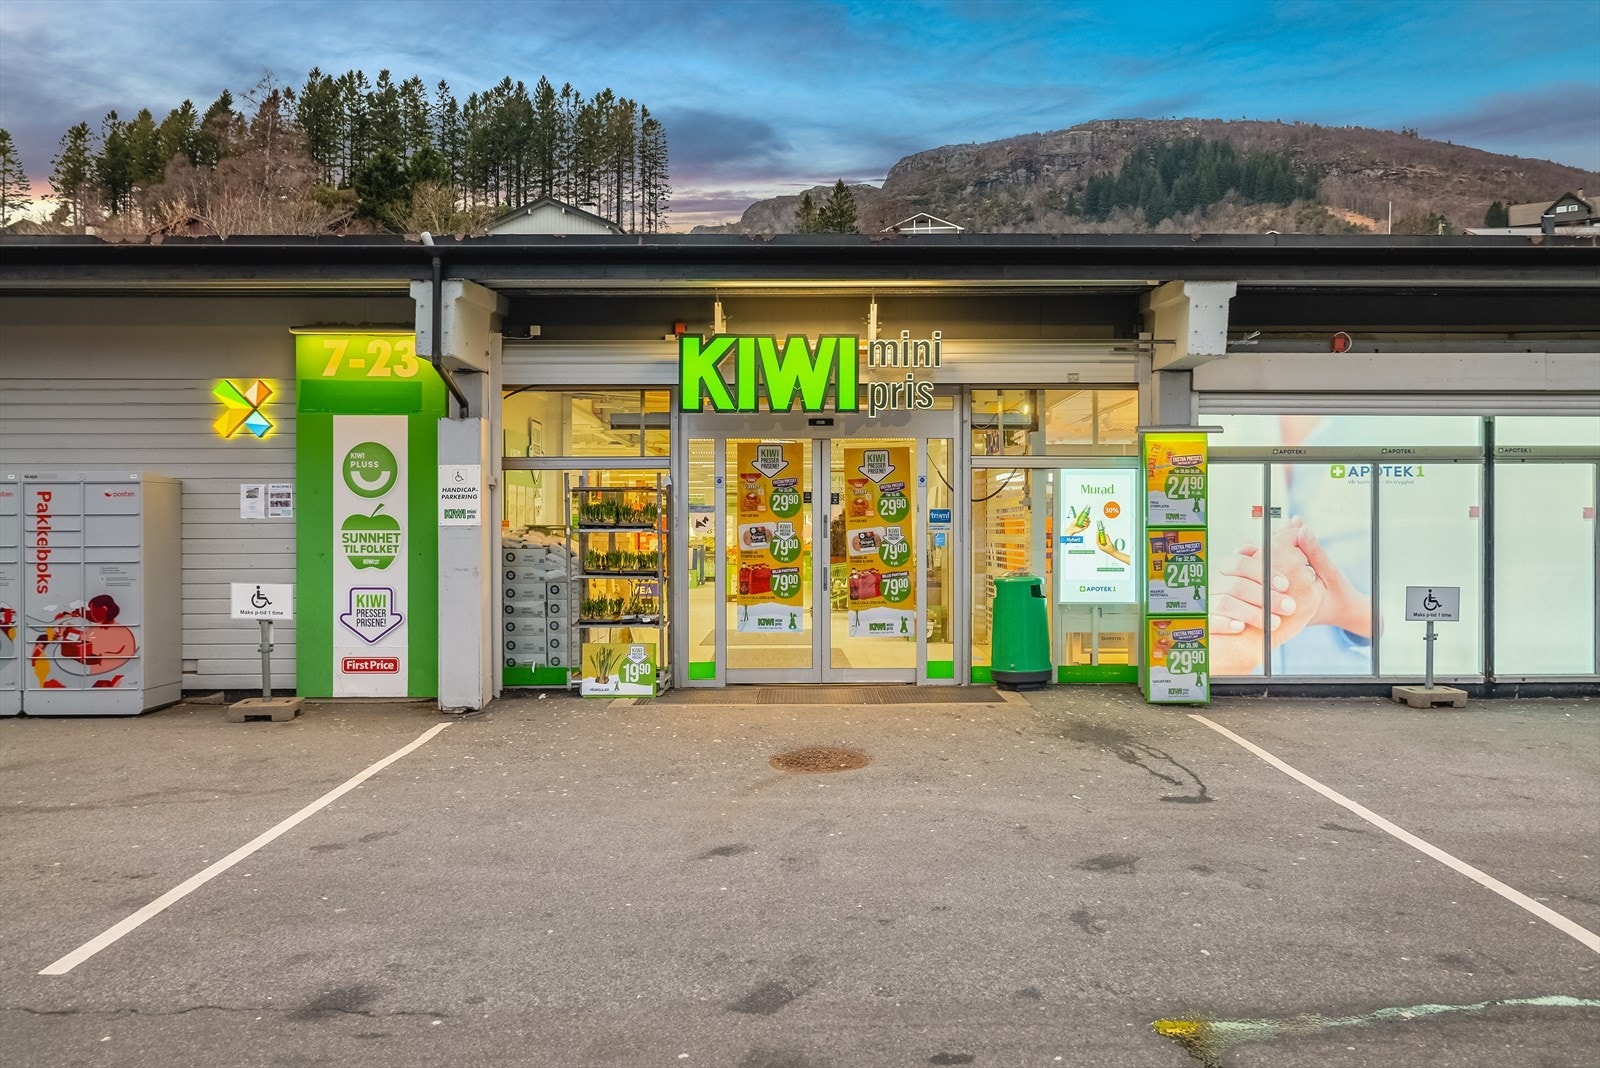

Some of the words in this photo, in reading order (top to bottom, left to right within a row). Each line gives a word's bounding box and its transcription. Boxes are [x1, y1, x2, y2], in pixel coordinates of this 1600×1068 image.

[322, 339, 419, 378] 7-23
[681, 334, 859, 413] KIWI
[868, 330, 942, 368] mini
[868, 373, 935, 418] pris
[760, 449, 780, 458] KIWI
[867, 454, 886, 462] KIWI
[1416, 466, 1424, 476] 1
[444, 509, 466, 519] KIWI
[36, 491, 52, 594] Pakkeboks
[342, 532, 400, 543] SUNNHET
[344, 545, 358, 554] TIL
[360, 545, 399, 554] FOLKET
[356, 594, 386, 608] KIWI
[356, 608, 386, 618] PRESSER
[356, 618, 386, 628] PRISENE!
[758, 618, 774, 626] KIWI
[869, 622, 886, 631] KIWI
[346, 660, 368, 670] First
[370, 660, 394, 670] Price
